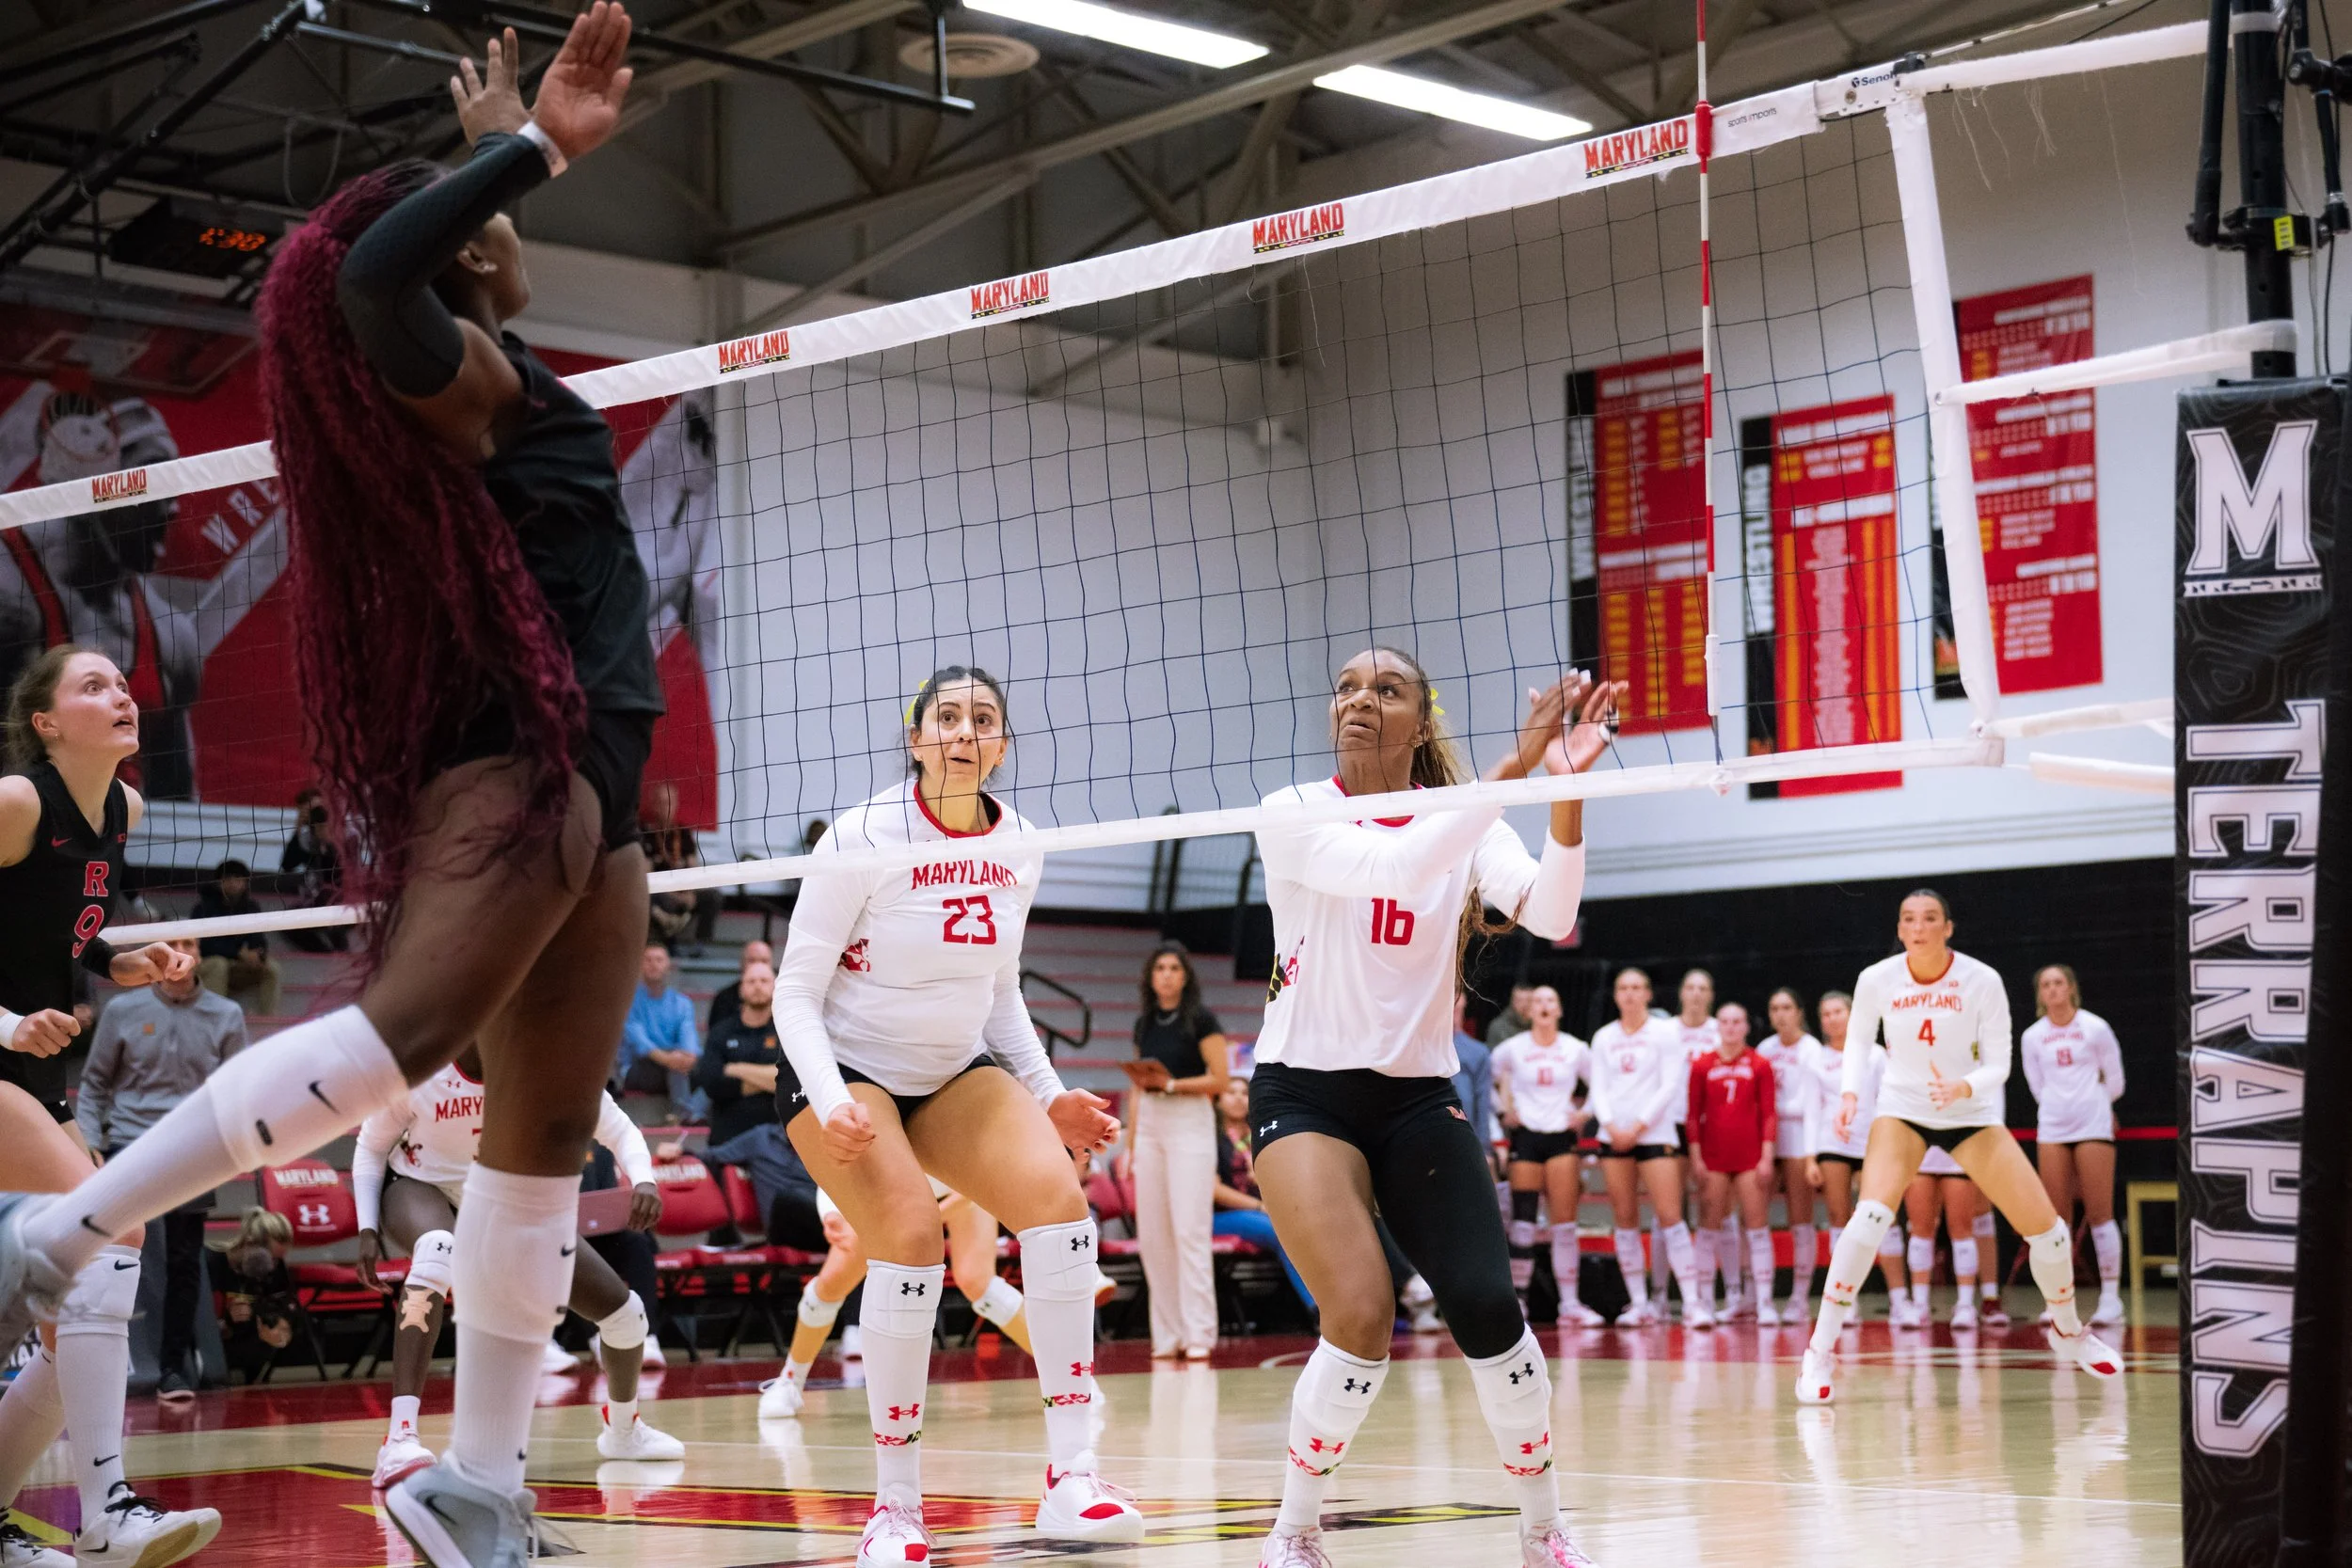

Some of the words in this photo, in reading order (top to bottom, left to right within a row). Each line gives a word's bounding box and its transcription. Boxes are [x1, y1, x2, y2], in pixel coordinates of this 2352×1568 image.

[1583, 119, 1689, 171] MARYLAND
[1252, 202, 1344, 248] MARYLAND
[970, 271, 1049, 314] MARYLAND
[718, 330, 789, 369] MARYLAND
[91, 468, 147, 499] MARYLAND
[2185, 420, 2321, 576] M
[83, 861, 109, 897] R
[911, 859, 1018, 891] MARYLAND
[72, 904, 104, 958] 9
[942, 895, 997, 945] 23
[1371, 897, 1415, 946] 16
[1891, 992, 1963, 1012] MARYLAND
[1917, 1019, 1936, 1047] 4
[1723, 1079, 1738, 1104] 7
[2185, 698, 2327, 1459] TERRAPINS
[436, 1096, 484, 1123] MARY
